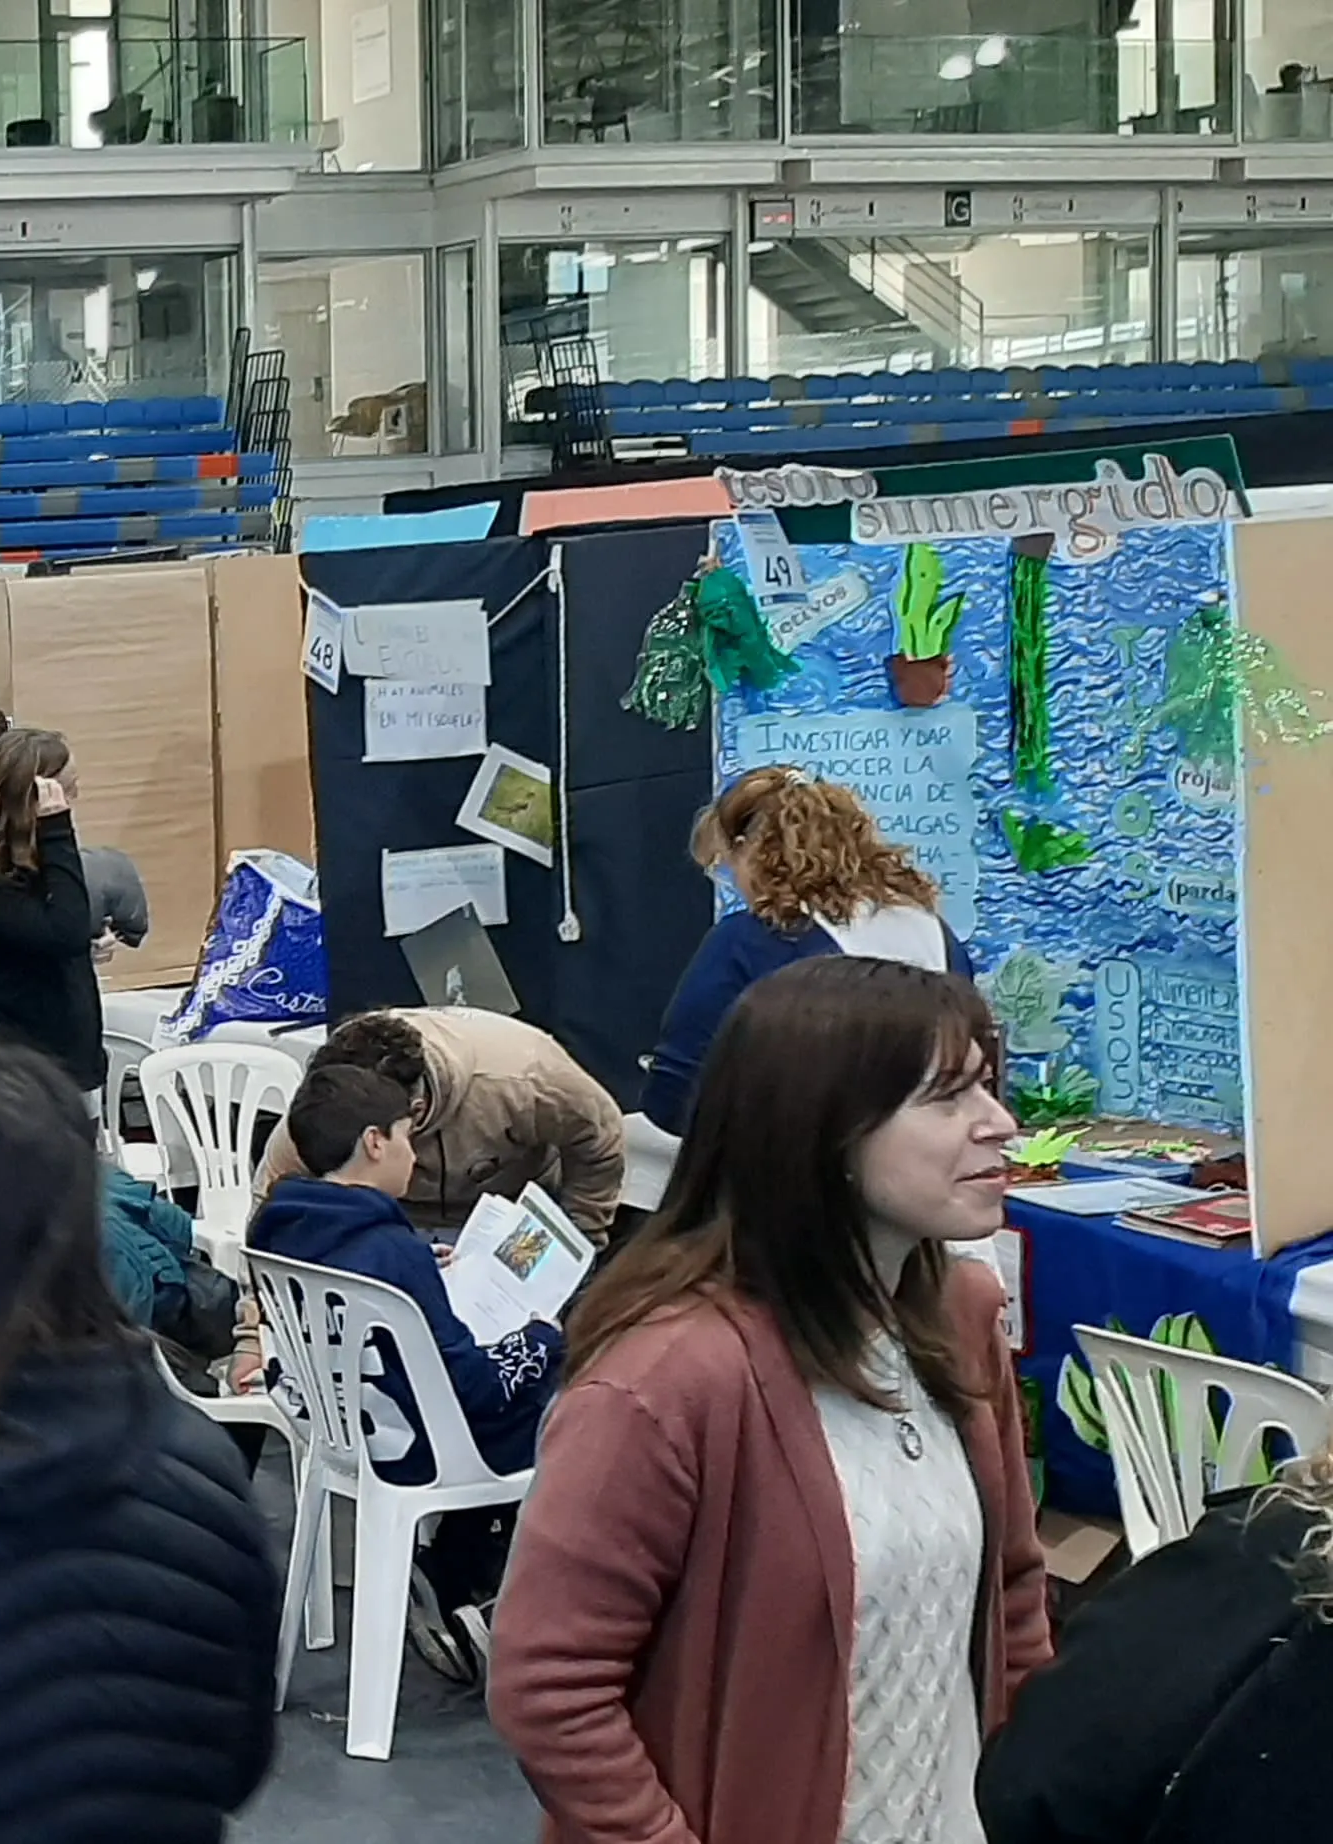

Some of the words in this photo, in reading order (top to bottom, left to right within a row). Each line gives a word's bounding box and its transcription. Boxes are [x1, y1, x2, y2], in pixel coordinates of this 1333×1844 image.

[950, 196, 970, 221] G
[856, 455, 1221, 558] sumergido
[763, 555, 792, 587] 49
[309, 635, 335, 672] 48
[900, 728, 913, 746] Y
[916, 727, 953, 747] DAR
[789, 757, 893, 777] ONOCER
[903, 755, 935, 775] LA
[926, 782, 955, 802] DE
[1167, 875, 1237, 906] (parda
